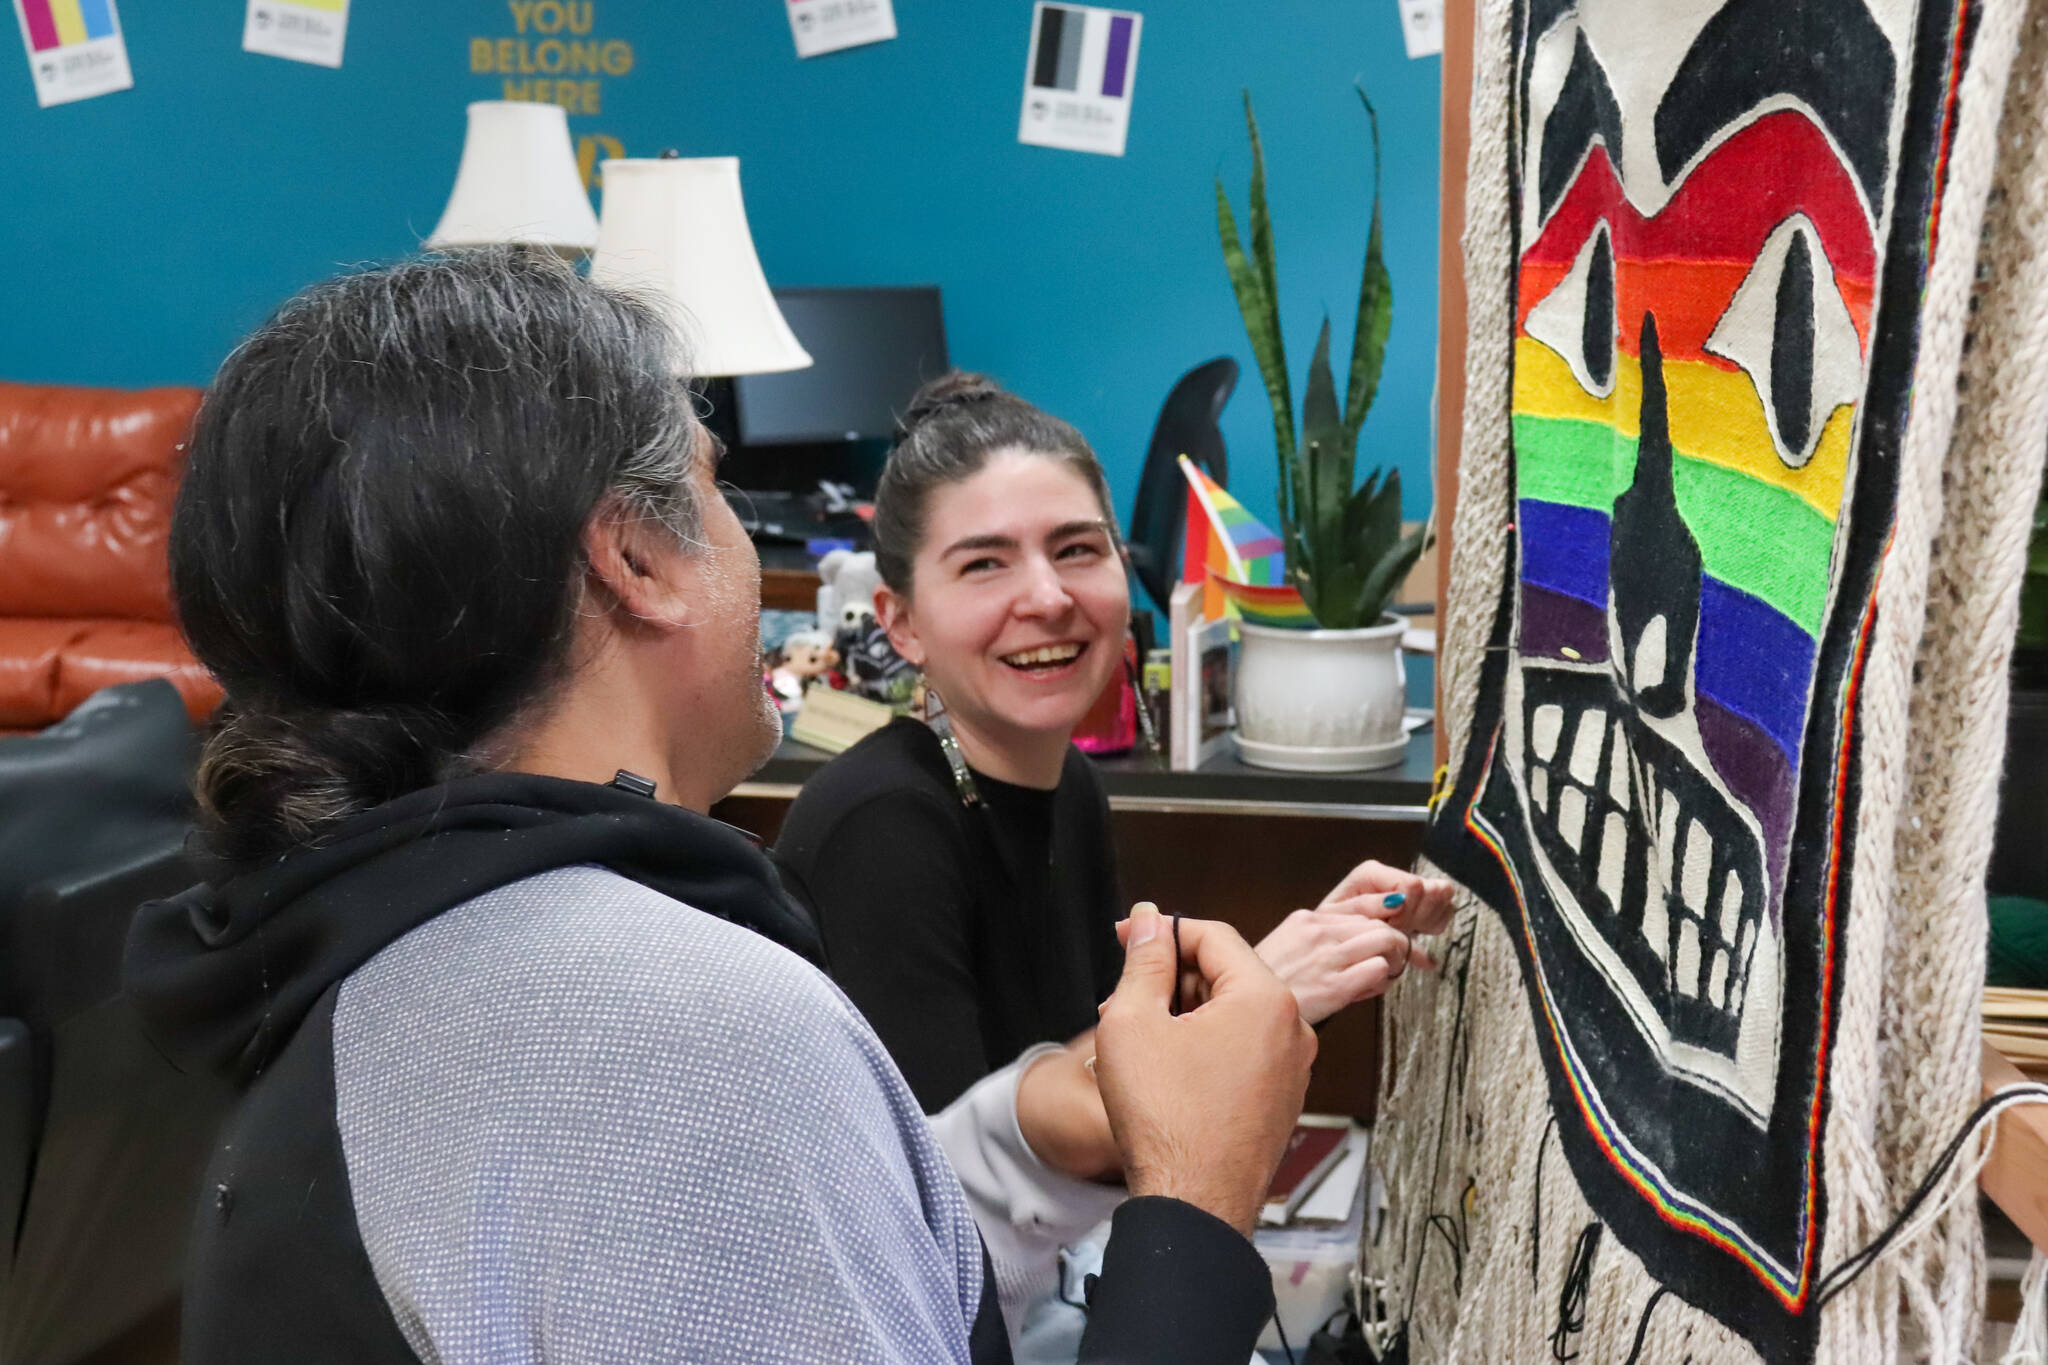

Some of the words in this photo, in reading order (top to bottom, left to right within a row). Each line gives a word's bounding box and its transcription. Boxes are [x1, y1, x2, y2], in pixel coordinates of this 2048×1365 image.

[510, 0, 593, 34] YOU
[470, 38, 633, 75] BELONG
[504, 80, 601, 114] HERE
